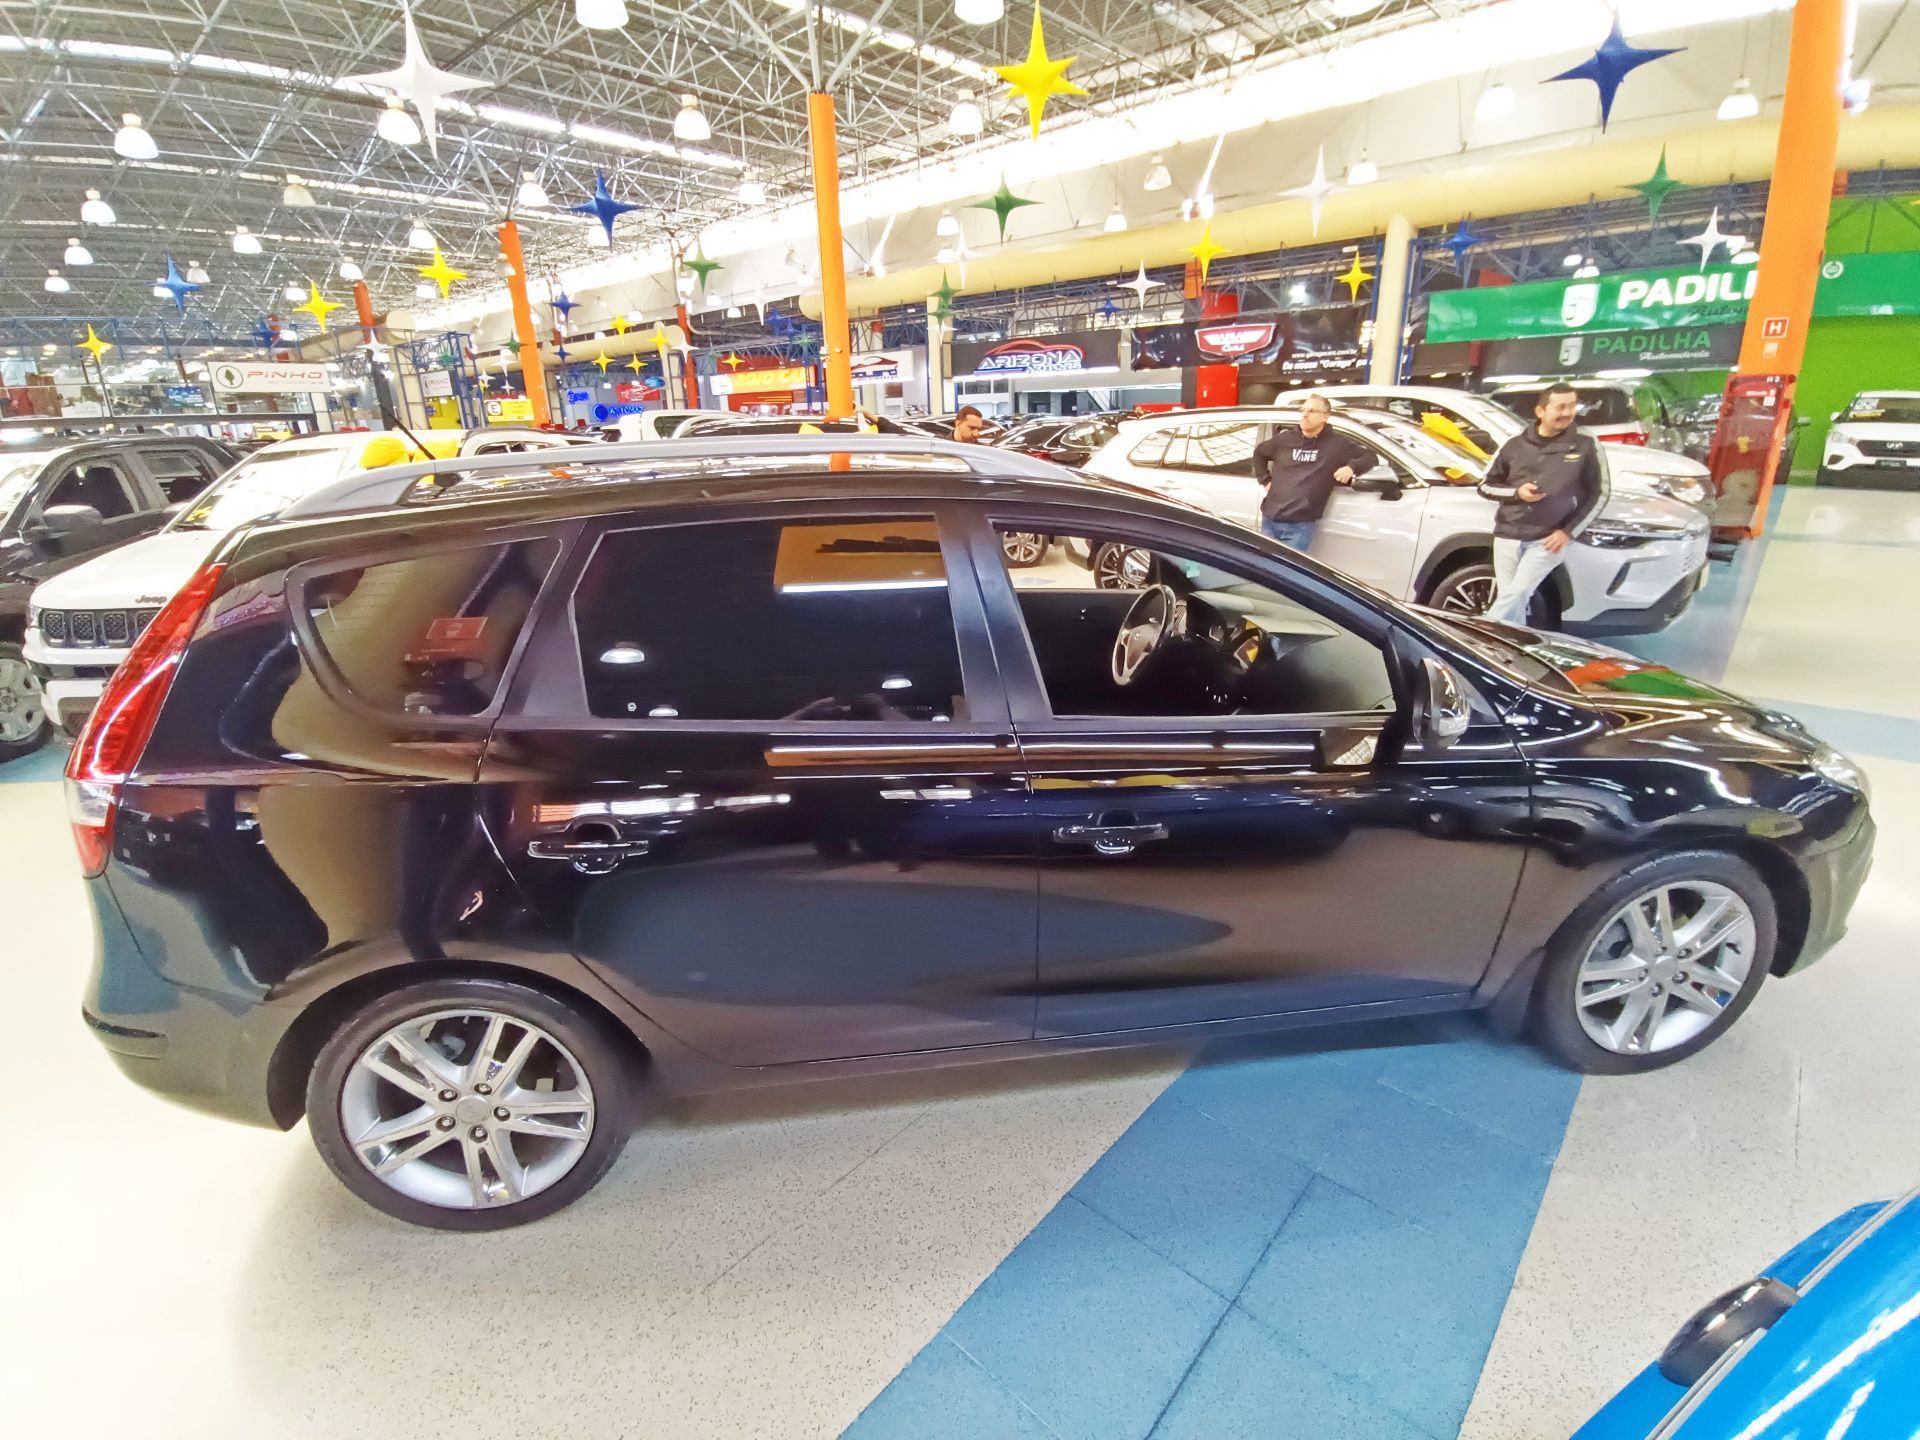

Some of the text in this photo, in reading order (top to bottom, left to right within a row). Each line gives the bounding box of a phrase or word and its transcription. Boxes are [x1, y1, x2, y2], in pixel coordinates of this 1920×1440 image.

[1769, 321, 1783, 334] H
[1593, 331, 1712, 354] PADILHA
[978, 350, 1082, 370] ARIZONA
[247, 371, 323, 379] PINHO
[736, 371, 775, 387] ROJO
[135, 595, 167, 604] Jeep
